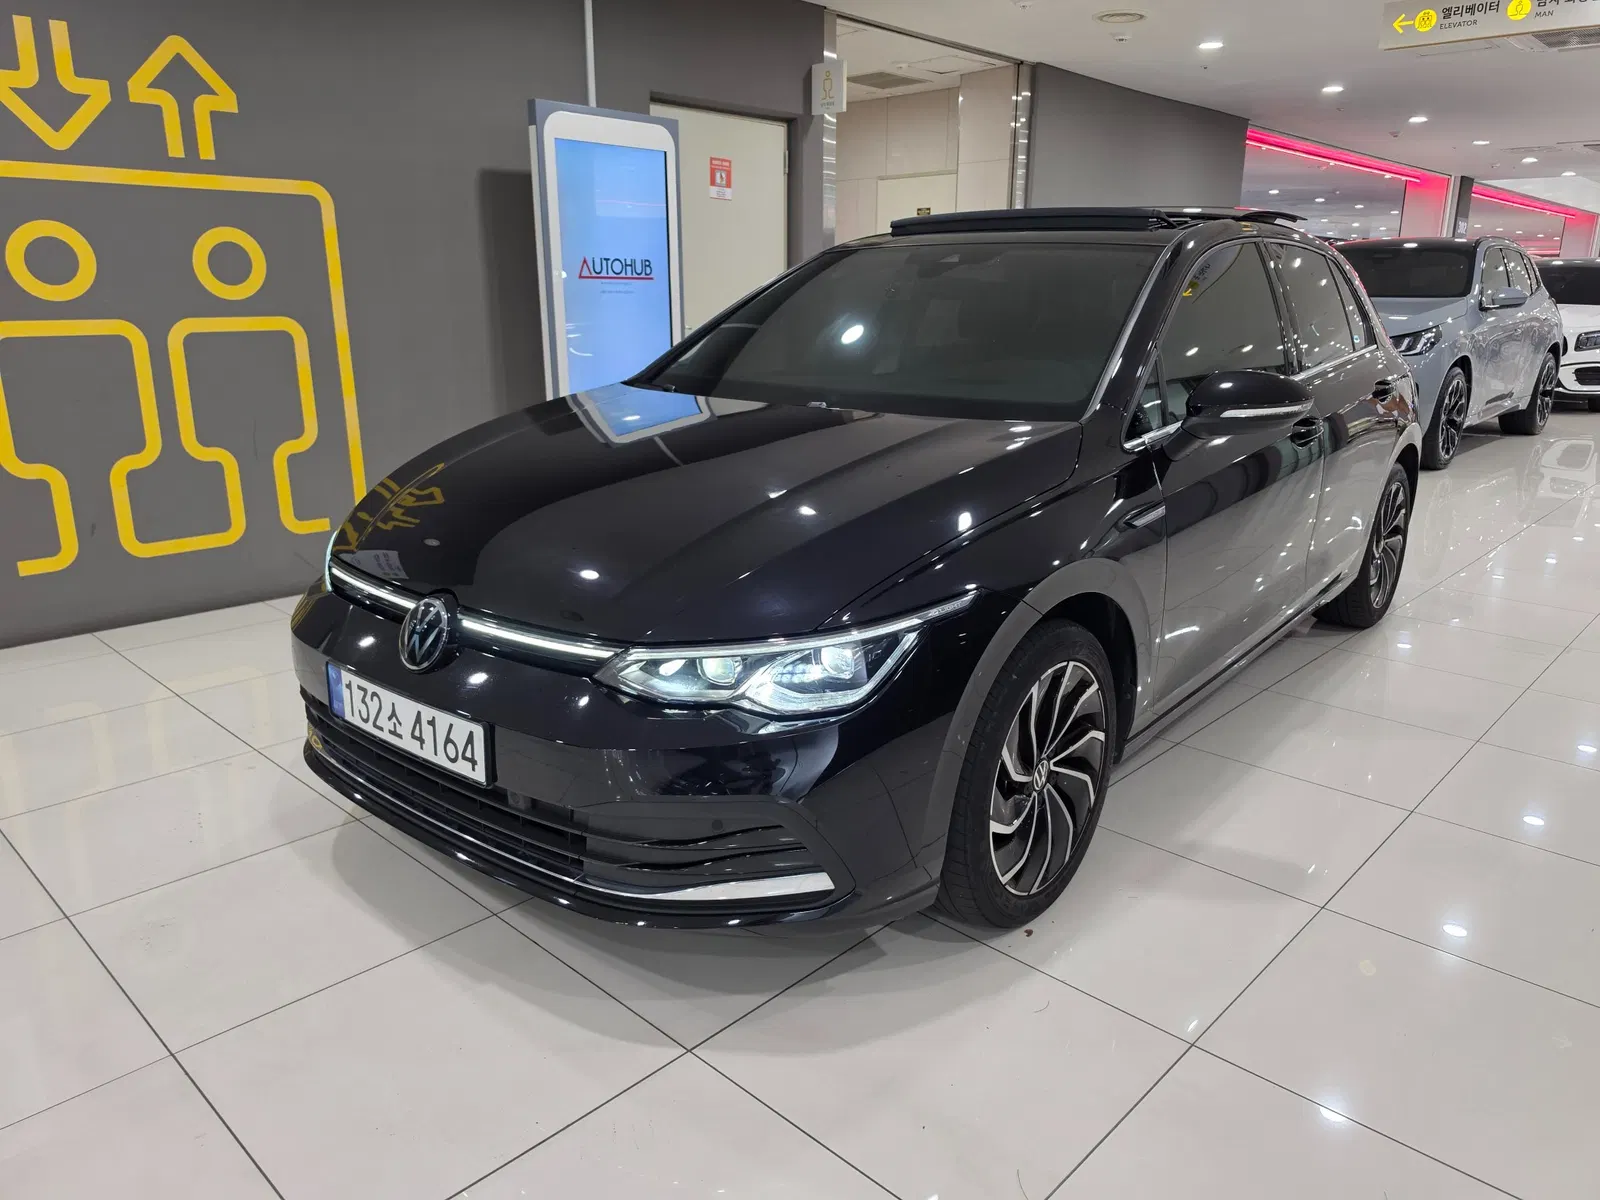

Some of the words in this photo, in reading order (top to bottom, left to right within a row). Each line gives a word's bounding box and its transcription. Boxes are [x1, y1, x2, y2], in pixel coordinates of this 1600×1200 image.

[1442, 0, 1500, 20] 엘리베이터
[1535, 10, 1554, 18] MAN
[1440, 20, 1478, 30] ELEVATOR
[578, 256, 654, 278] AUTOHUB
[411, 710, 481, 772] 4164
